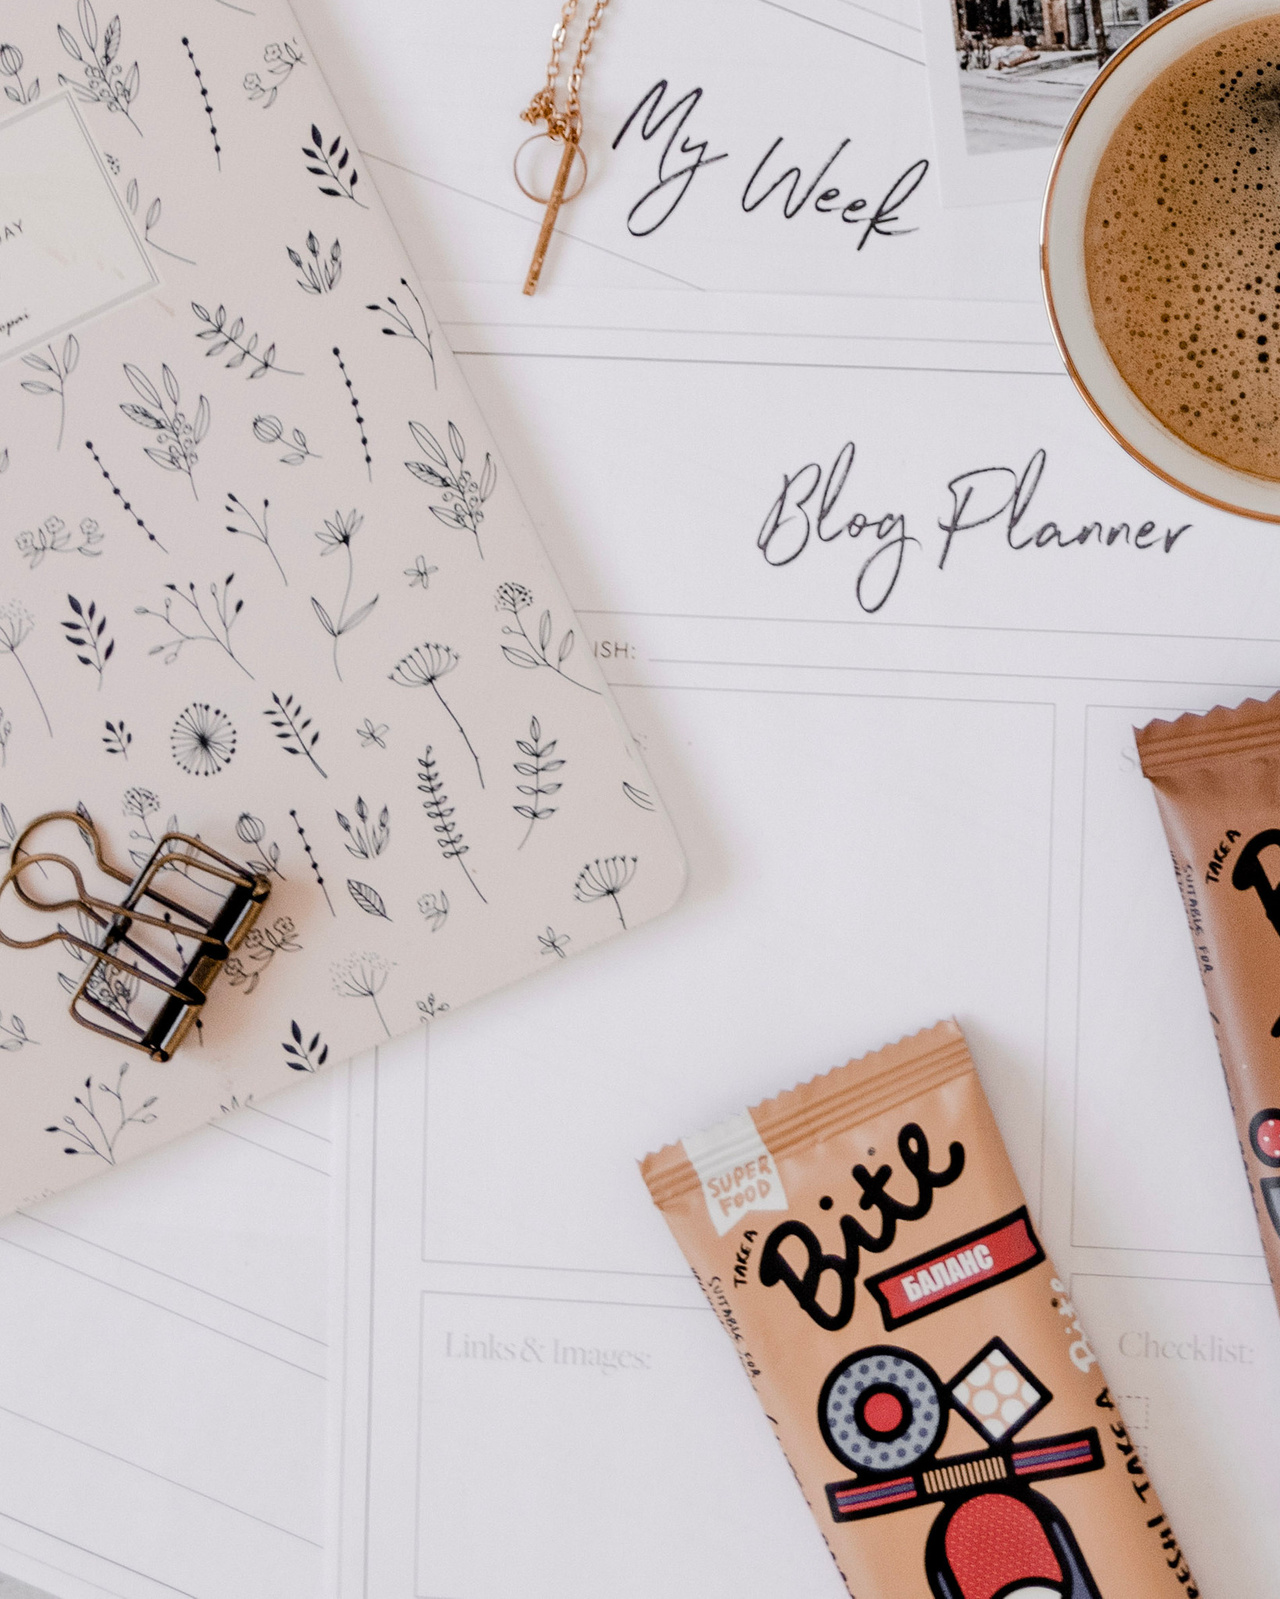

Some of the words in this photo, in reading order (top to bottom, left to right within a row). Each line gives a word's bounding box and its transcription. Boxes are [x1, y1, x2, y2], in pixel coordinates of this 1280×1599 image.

[612, 78, 727, 237] My
[742, 136, 933, 250] Week
[759, 440, 920, 613] Blog
[938, 448, 1192, 570] Planner
[594, 641, 635, 659] ISH:
[1205, 841, 1232, 884] TAKE
[1225, 828, 1242, 844] A
[707, 1154, 772, 1198] SUPER
[719, 1179, 771, 1217] FOOD
[758, 1122, 965, 1331] Bite
[734, 1243, 752, 1289] TAKE
[743, 1229, 758, 1243] A
[901, 1244, 994, 1303] БАЛАНС
[444, 1330, 517, 1361] Links
[520, 1336, 546, 1363] &
[552, 1338, 652, 1376] Images:
